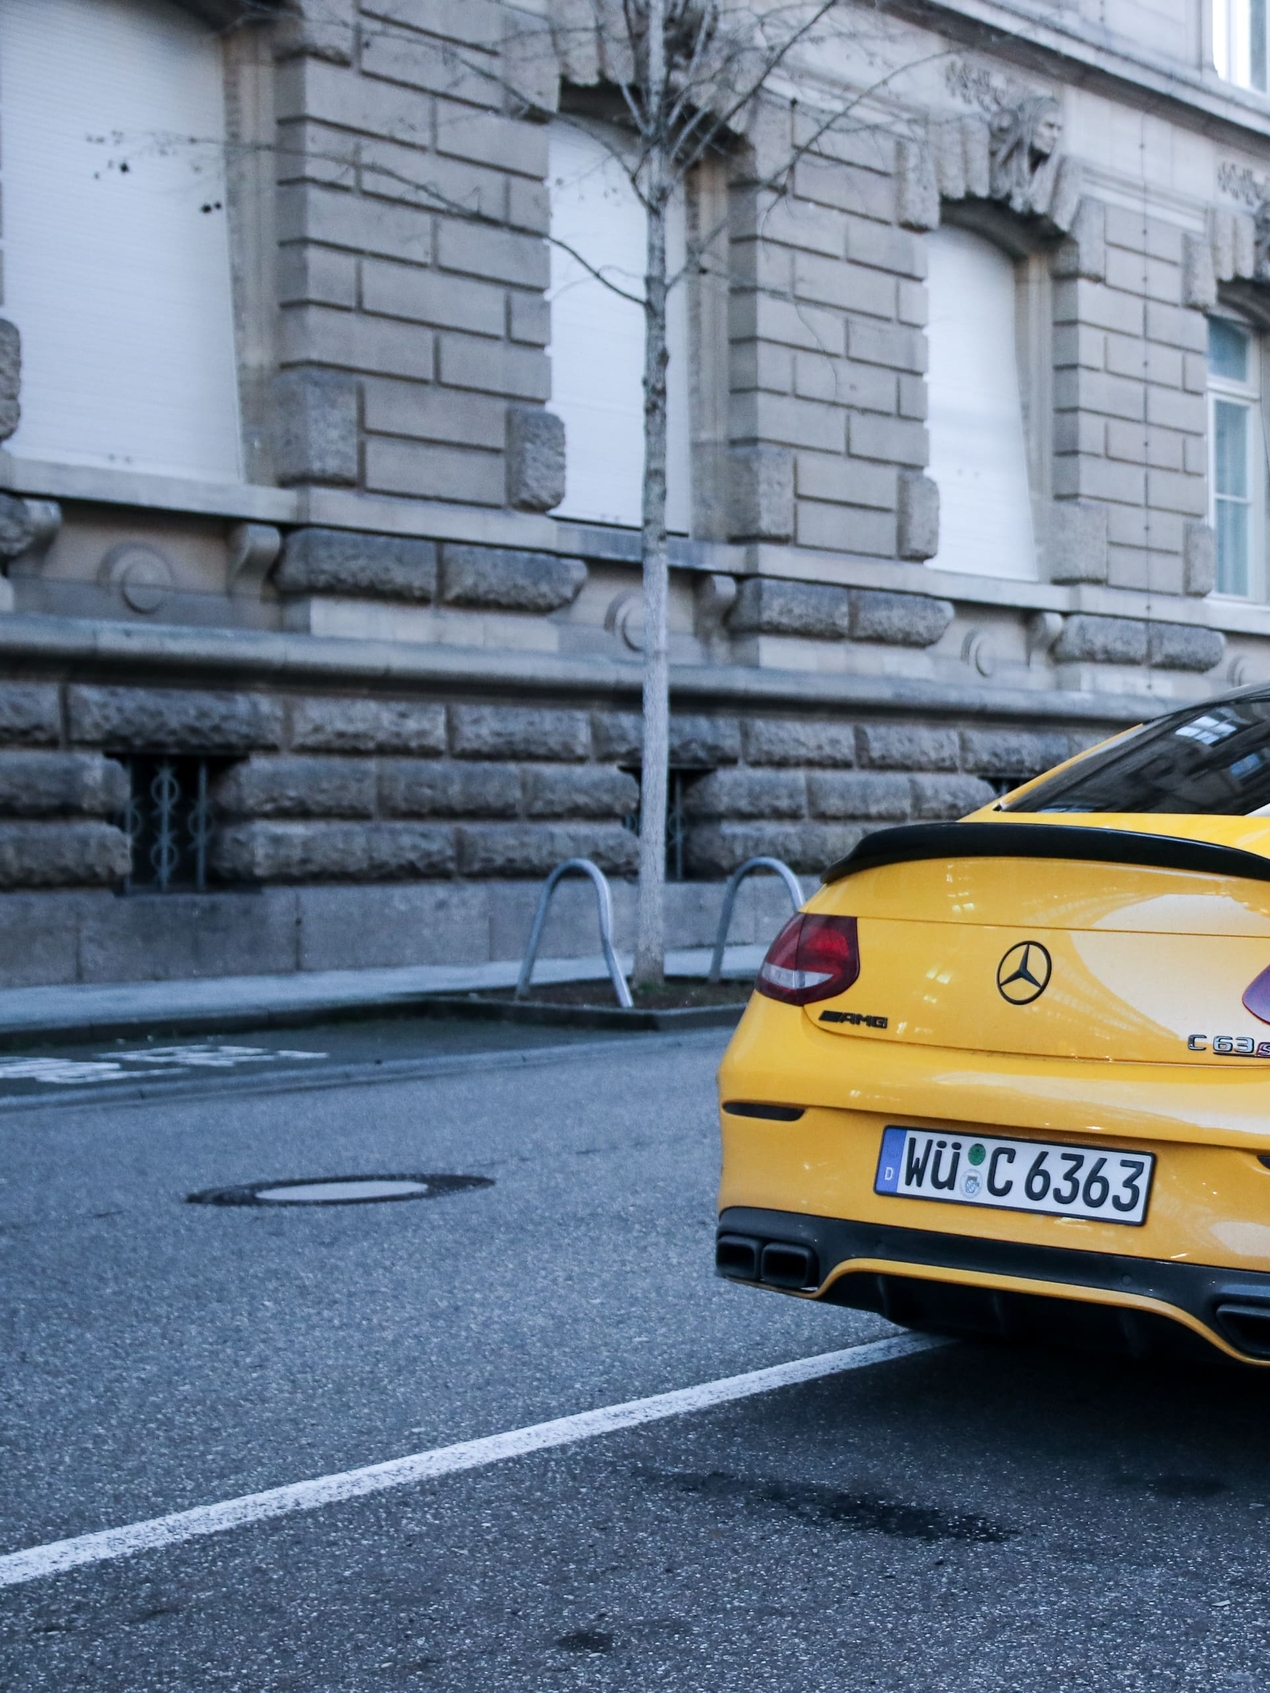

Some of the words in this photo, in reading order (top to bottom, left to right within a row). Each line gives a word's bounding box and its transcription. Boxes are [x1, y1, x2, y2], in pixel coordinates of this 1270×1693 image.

[838, 1011, 888, 1029] AMG
[1187, 1034, 1207, 1051] C
[884, 1166, 893, 1181] D
[904, 1137, 962, 1191] WÜ
[987, 1146, 1016, 1197] C
[1024, 1151, 1145, 1212] 6363
